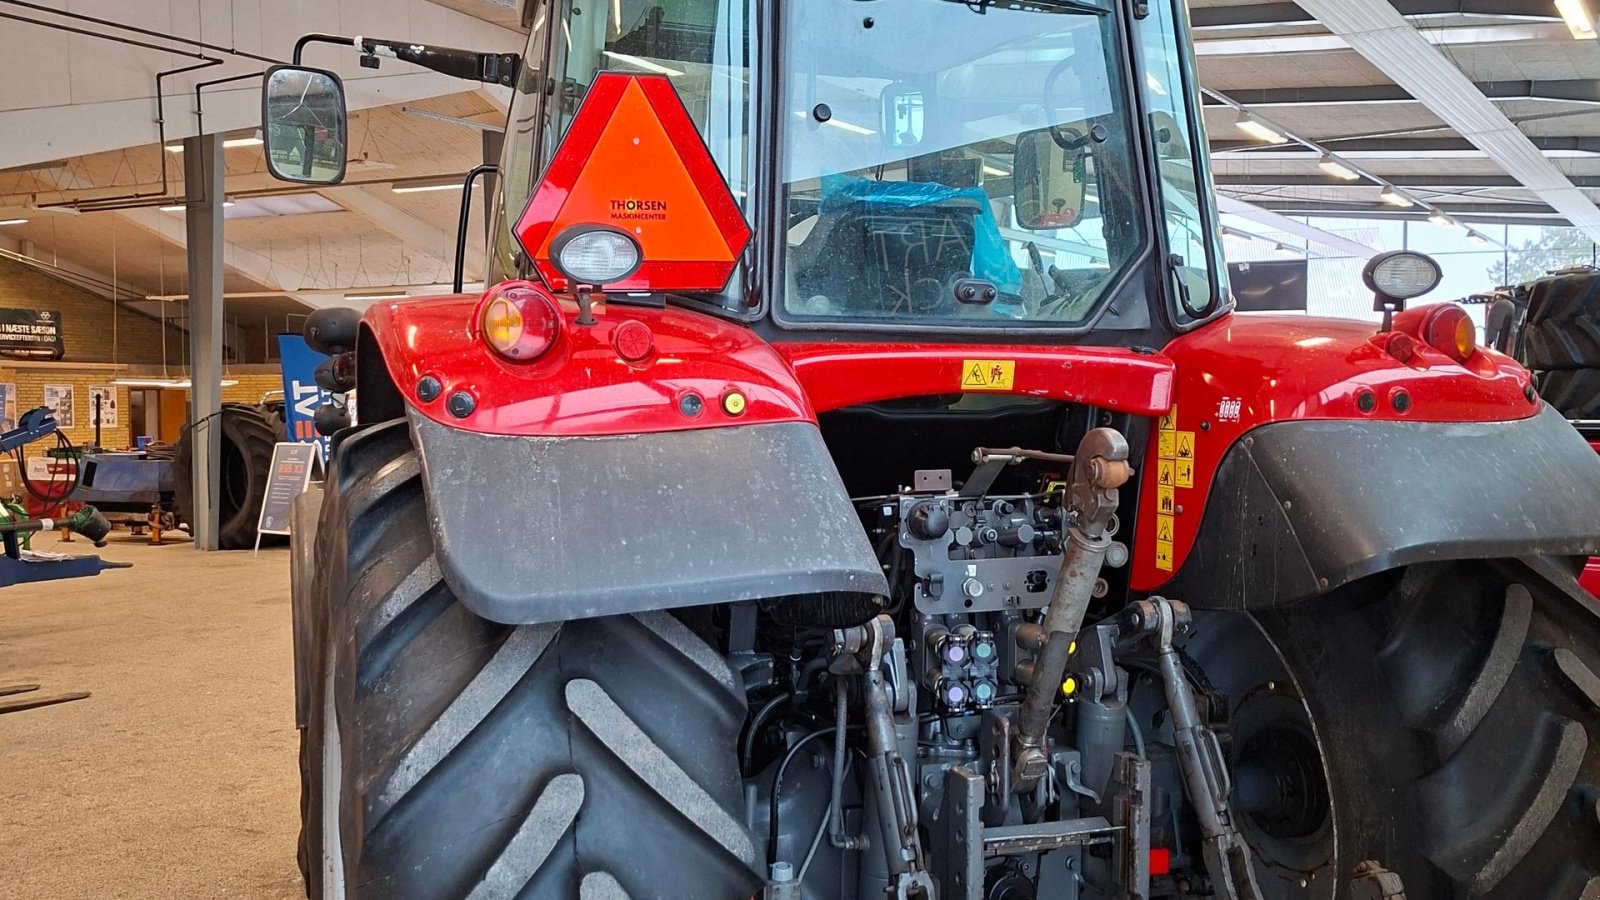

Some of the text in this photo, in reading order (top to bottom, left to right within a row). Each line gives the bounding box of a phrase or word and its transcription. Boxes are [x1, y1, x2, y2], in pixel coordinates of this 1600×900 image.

[610, 199, 667, 211] THORSEN
[610, 212, 667, 220] MASKINCENTER
[5, 324, 30, 334] NÆSTE
[30, 325, 56, 335] SÆSON
